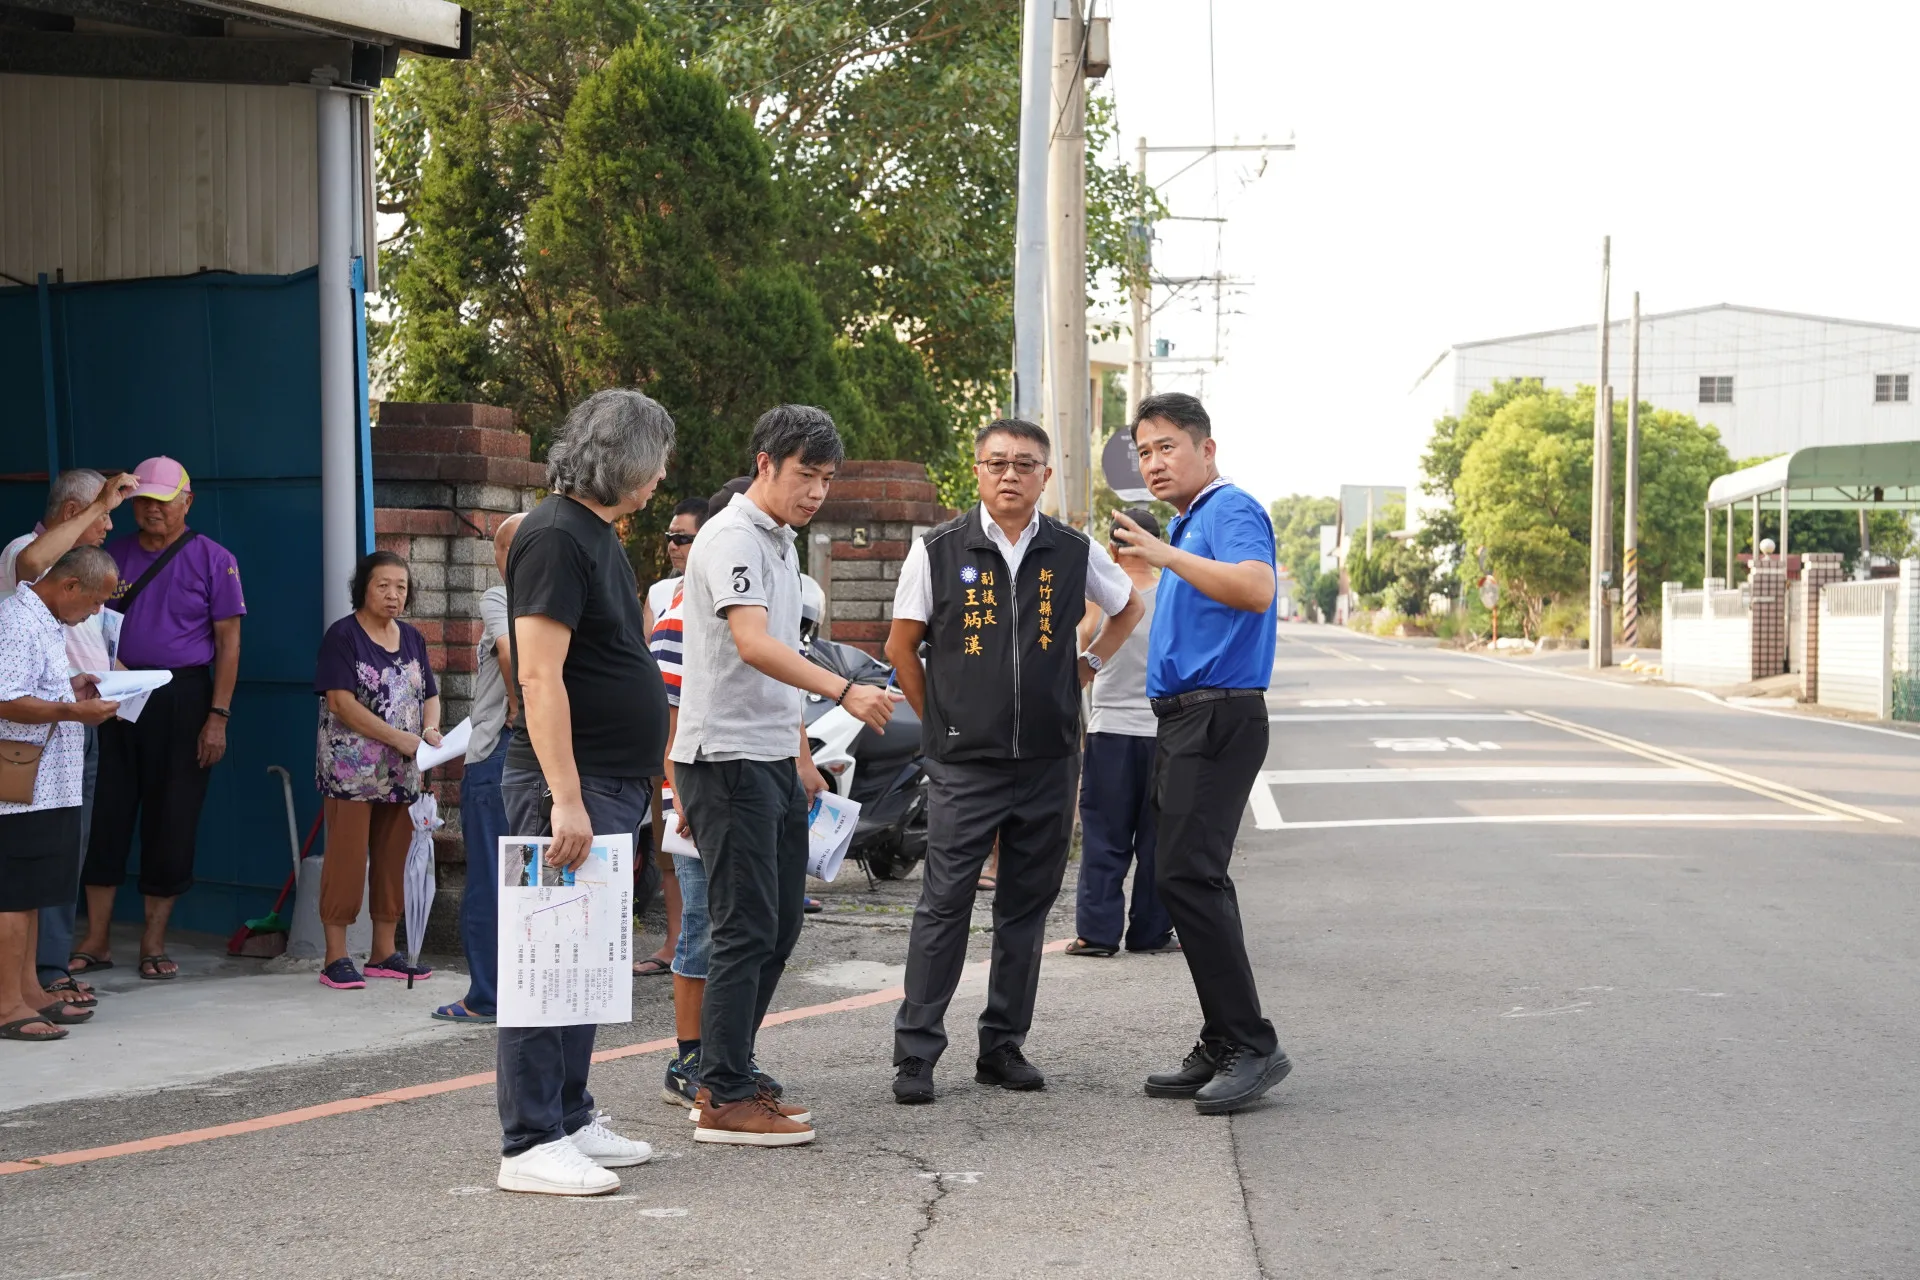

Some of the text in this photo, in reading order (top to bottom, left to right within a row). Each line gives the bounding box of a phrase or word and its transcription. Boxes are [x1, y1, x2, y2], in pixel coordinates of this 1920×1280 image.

[732, 566, 750, 593] 3
[980, 571, 997, 625] 副議長
[1038, 568, 1054, 651] 新竹縣議會
[963, 588, 983, 656] 王炳漢
